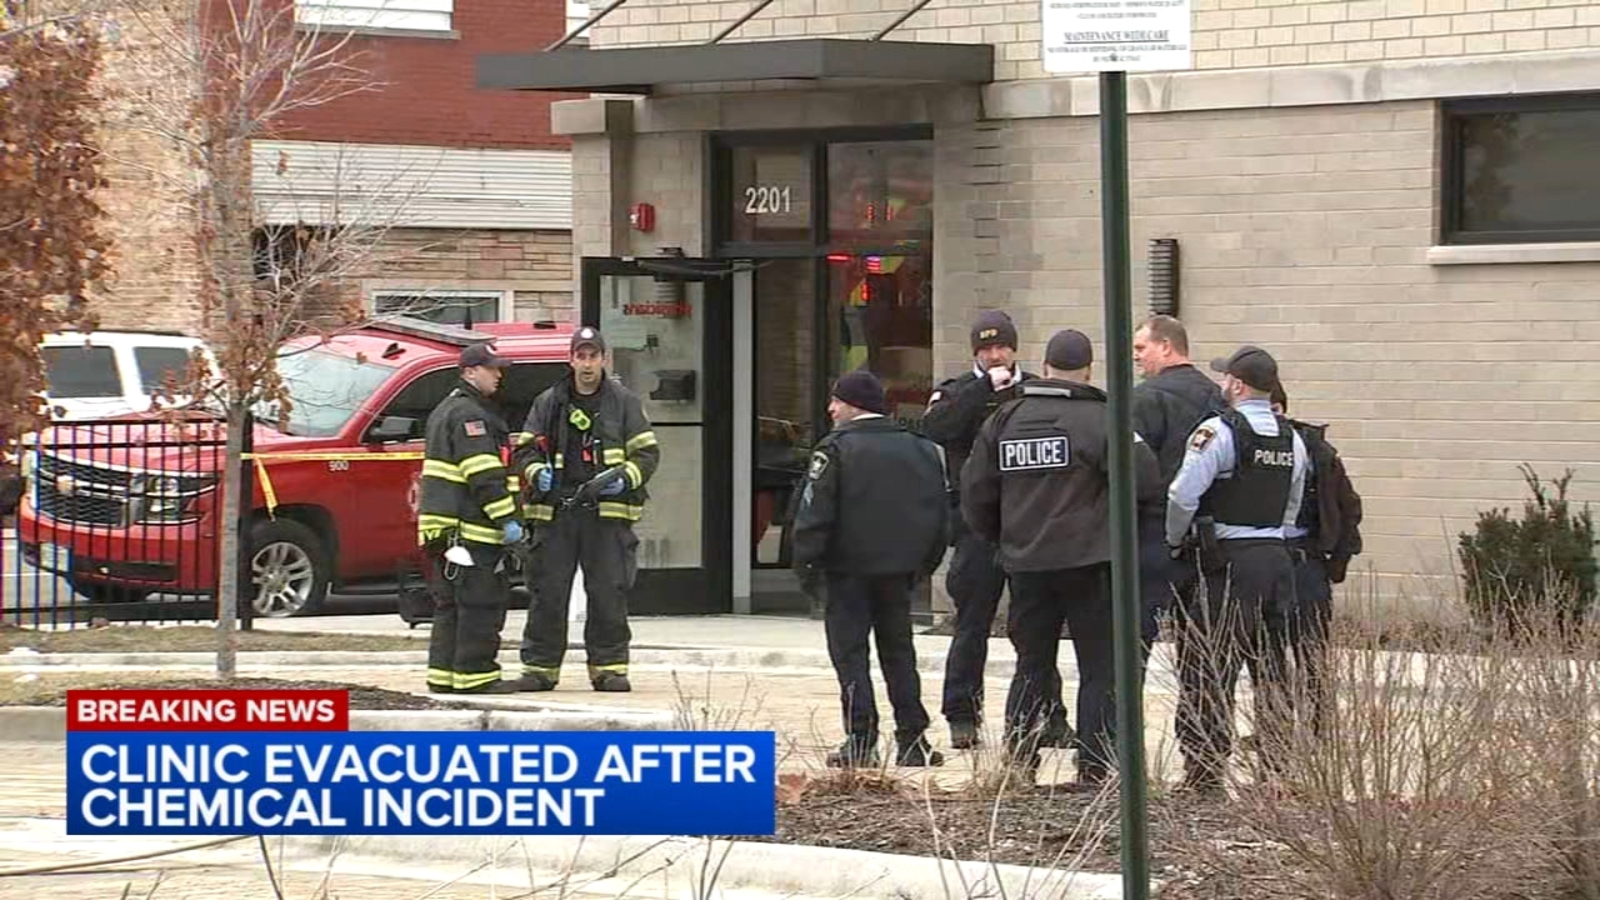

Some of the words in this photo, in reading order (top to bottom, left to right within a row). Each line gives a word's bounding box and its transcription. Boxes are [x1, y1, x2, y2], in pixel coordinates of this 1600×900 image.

[745, 187, 790, 213] 2201
[1005, 441, 1062, 466] POLICE
[1254, 449, 1293, 467] POLICE
